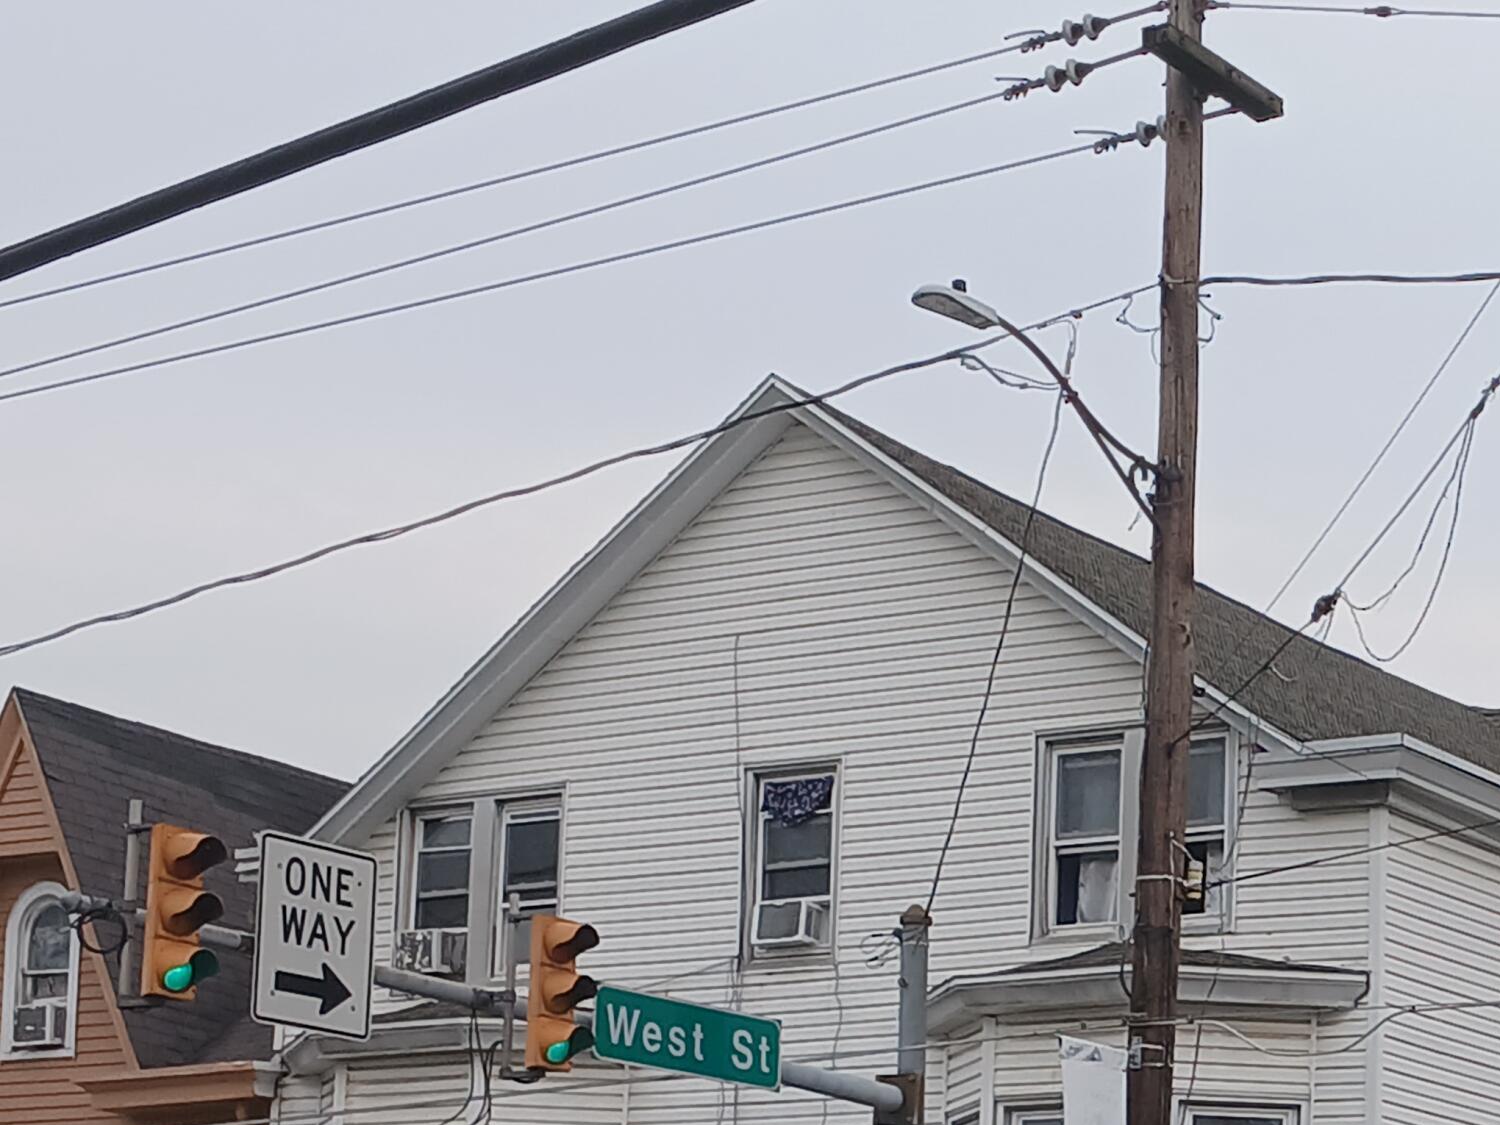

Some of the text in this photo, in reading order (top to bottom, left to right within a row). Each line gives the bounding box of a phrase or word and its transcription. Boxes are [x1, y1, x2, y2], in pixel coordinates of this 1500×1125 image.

[285, 856, 355, 908] ONE
[281, 904, 356, 956] WAY
[606, 1003, 771, 1073] West St
